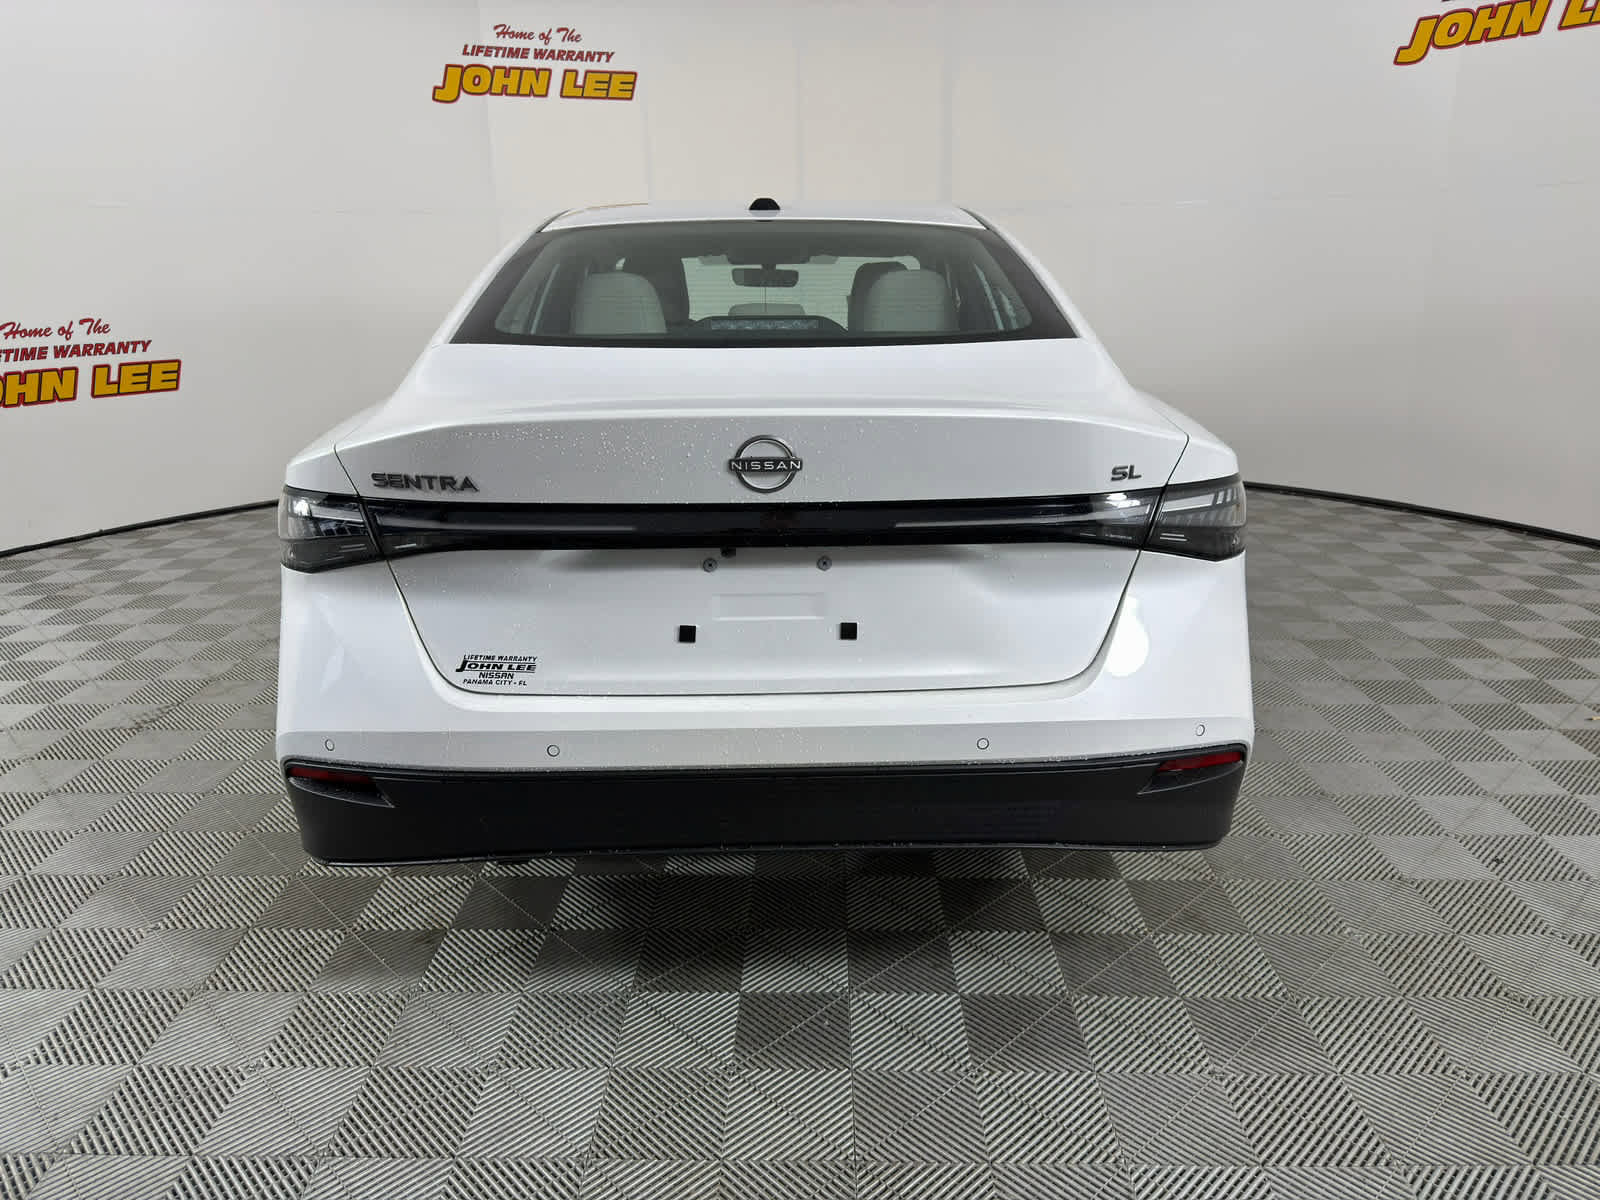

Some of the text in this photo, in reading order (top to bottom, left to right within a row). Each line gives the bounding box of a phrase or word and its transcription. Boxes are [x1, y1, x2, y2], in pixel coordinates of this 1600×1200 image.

[493, 23, 582, 46] Home of The
[1393, 0, 1553, 66] JOHN
[462, 44, 616, 63] LIFETIME WARRANTY
[432, 64, 638, 104] JOHN LEE
[0, 317, 111, 341] Home of The
[53, 339, 153, 359] WARRANTY
[91, 359, 182, 399] LEE
[730, 460, 802, 471] NISSAN
[1110, 464, 1142, 481] SL
[371, 472, 479, 492] SENTRA
[455, 659, 537, 673] JOHN LEE
[478, 672, 515, 680] NISSAN
